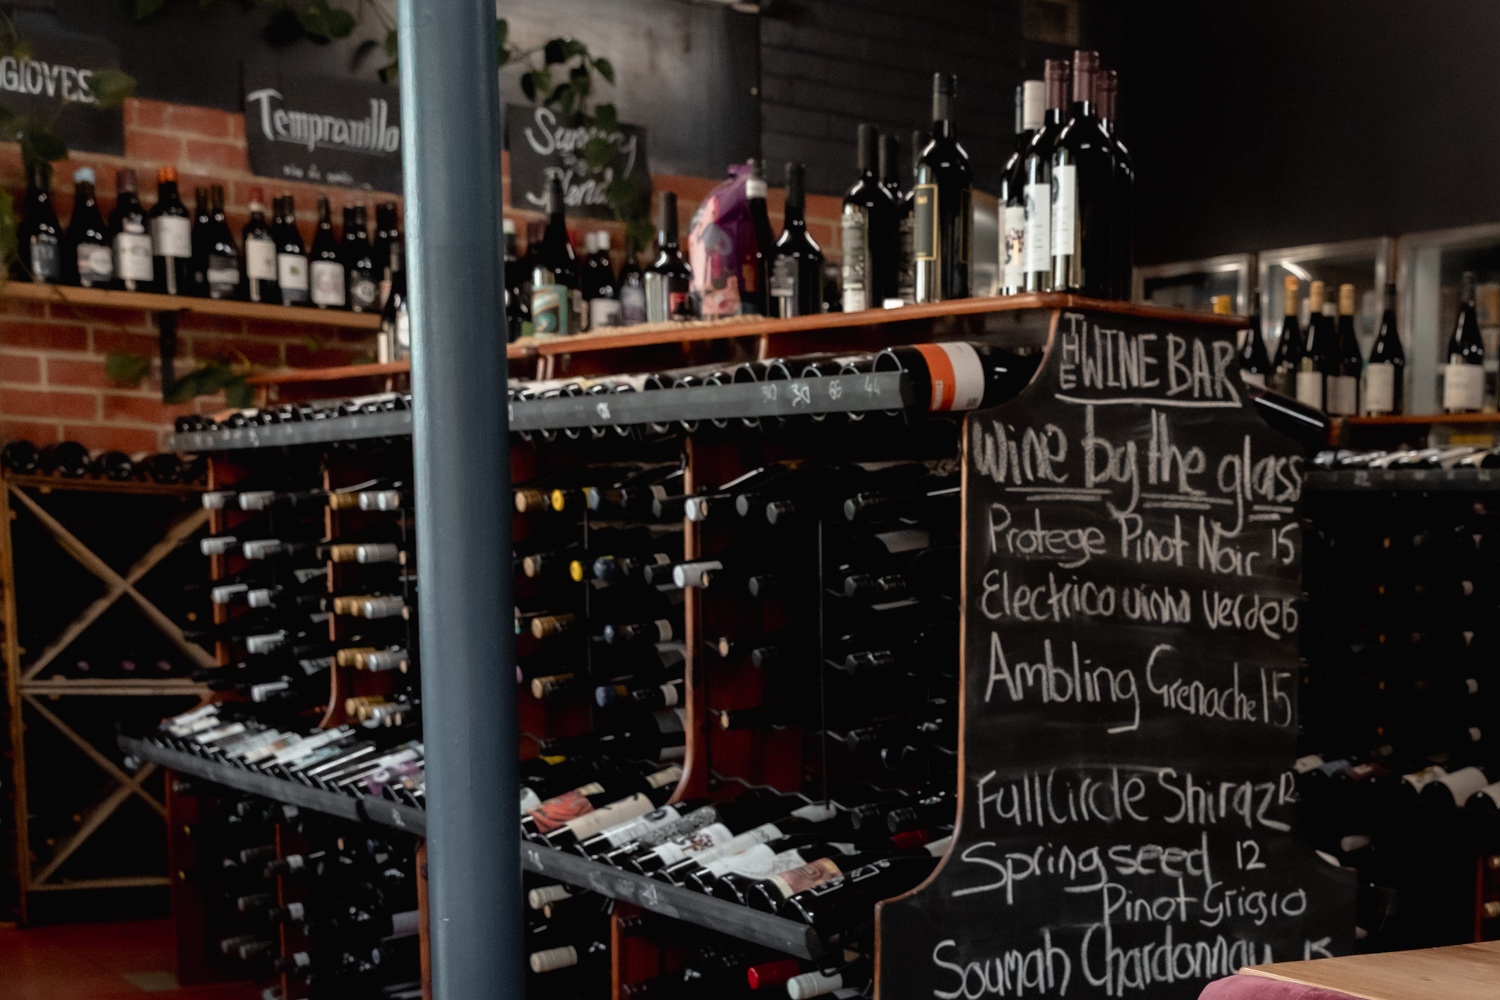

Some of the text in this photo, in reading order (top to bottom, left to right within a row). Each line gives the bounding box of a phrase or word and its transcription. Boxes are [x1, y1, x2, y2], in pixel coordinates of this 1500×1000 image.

[0, 56, 101, 105] GIOVES
[247, 88, 400, 153] Tempranillo
[1060, 312, 1242, 404] THE WINE BAR
[972, 404, 1304, 537] Wine by the glass
[989, 502, 1299, 576] Protege Pinot Noir 15
[980, 569, 1115, 623] Electrico
[984, 631, 1292, 734] Ambling Grenache 15
[1158, 766, 1291, 833] Shiraz
[1236, 840, 1267, 870] 12
[1103, 876, 1307, 928] Pinot Grigio
